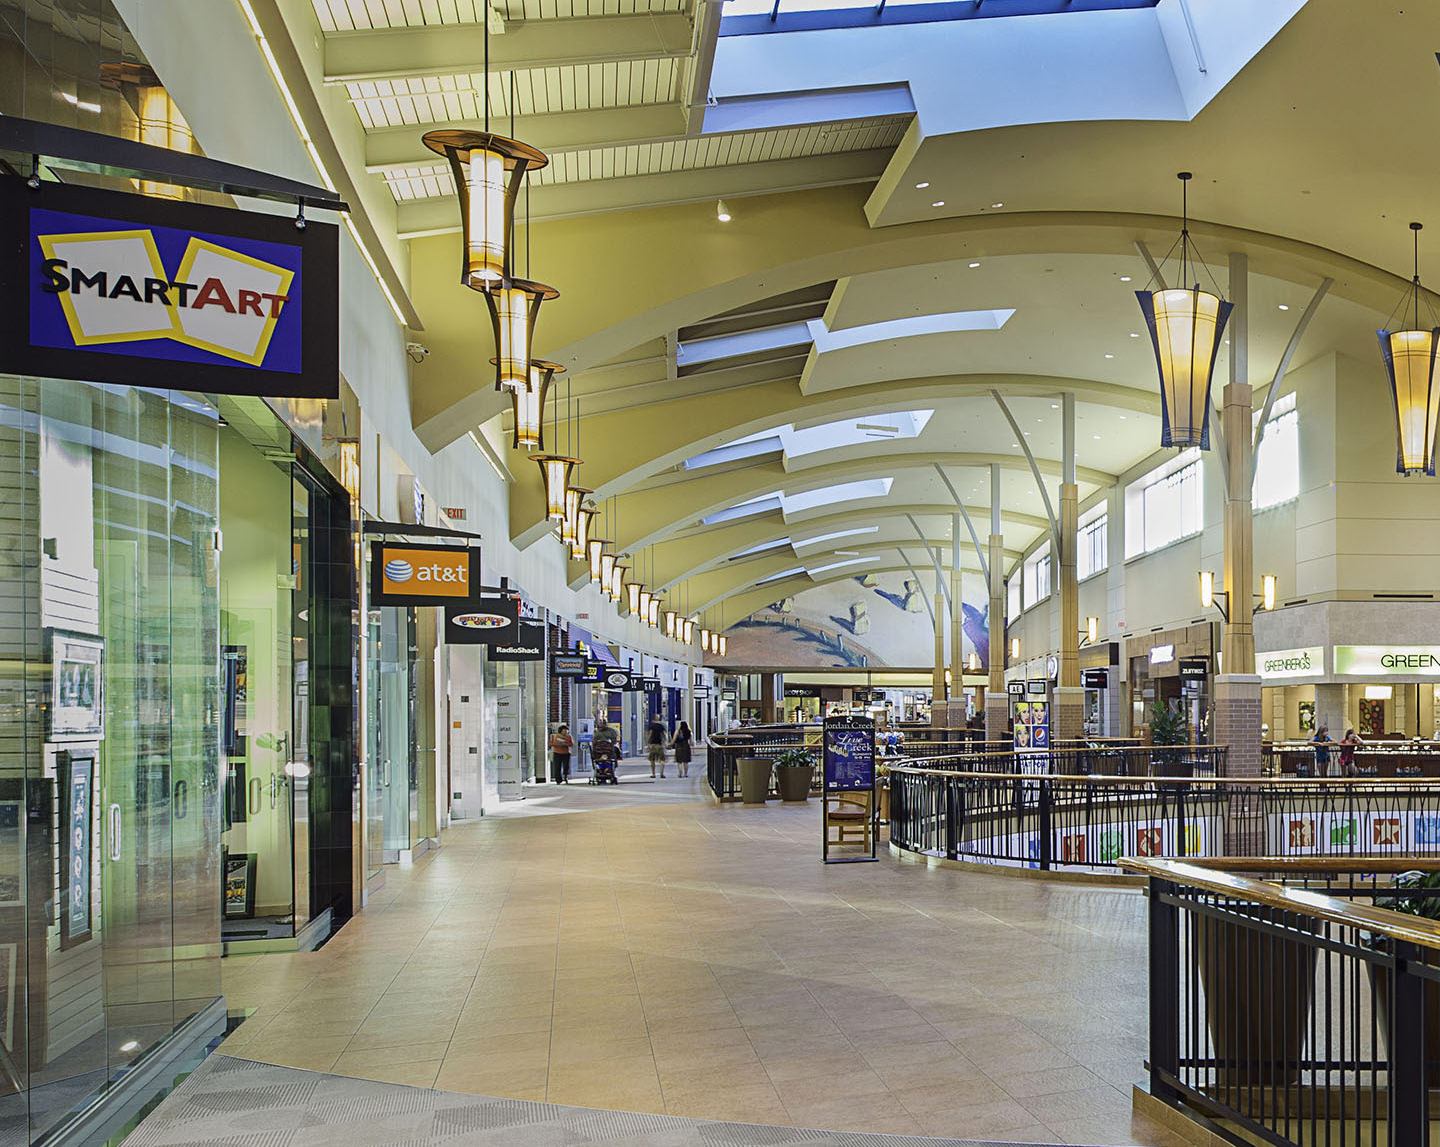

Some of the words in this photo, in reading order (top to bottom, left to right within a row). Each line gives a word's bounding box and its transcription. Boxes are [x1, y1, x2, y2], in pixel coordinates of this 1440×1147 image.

[447, 508, 464, 519] EXIT
[416, 563, 467, 583] at&t
[496, 646, 540, 654] RadioShack
[825, 722, 850, 730] Jordan
